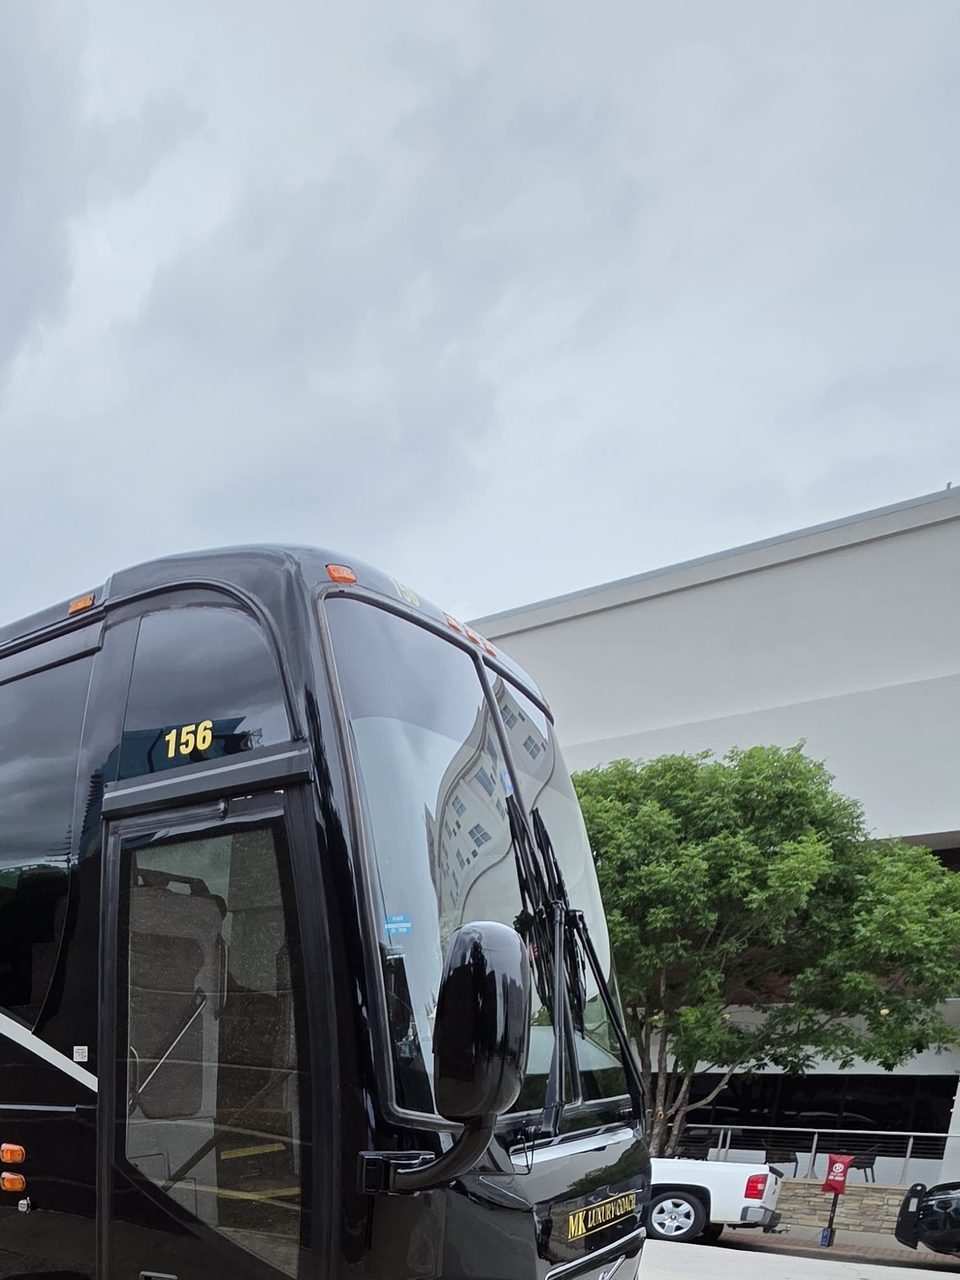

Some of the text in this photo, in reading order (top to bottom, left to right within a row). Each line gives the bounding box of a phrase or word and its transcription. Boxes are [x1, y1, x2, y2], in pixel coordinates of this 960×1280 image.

[165, 719, 213, 758] 156
[568, 1193, 637, 1239] MK LUXURY COACH
